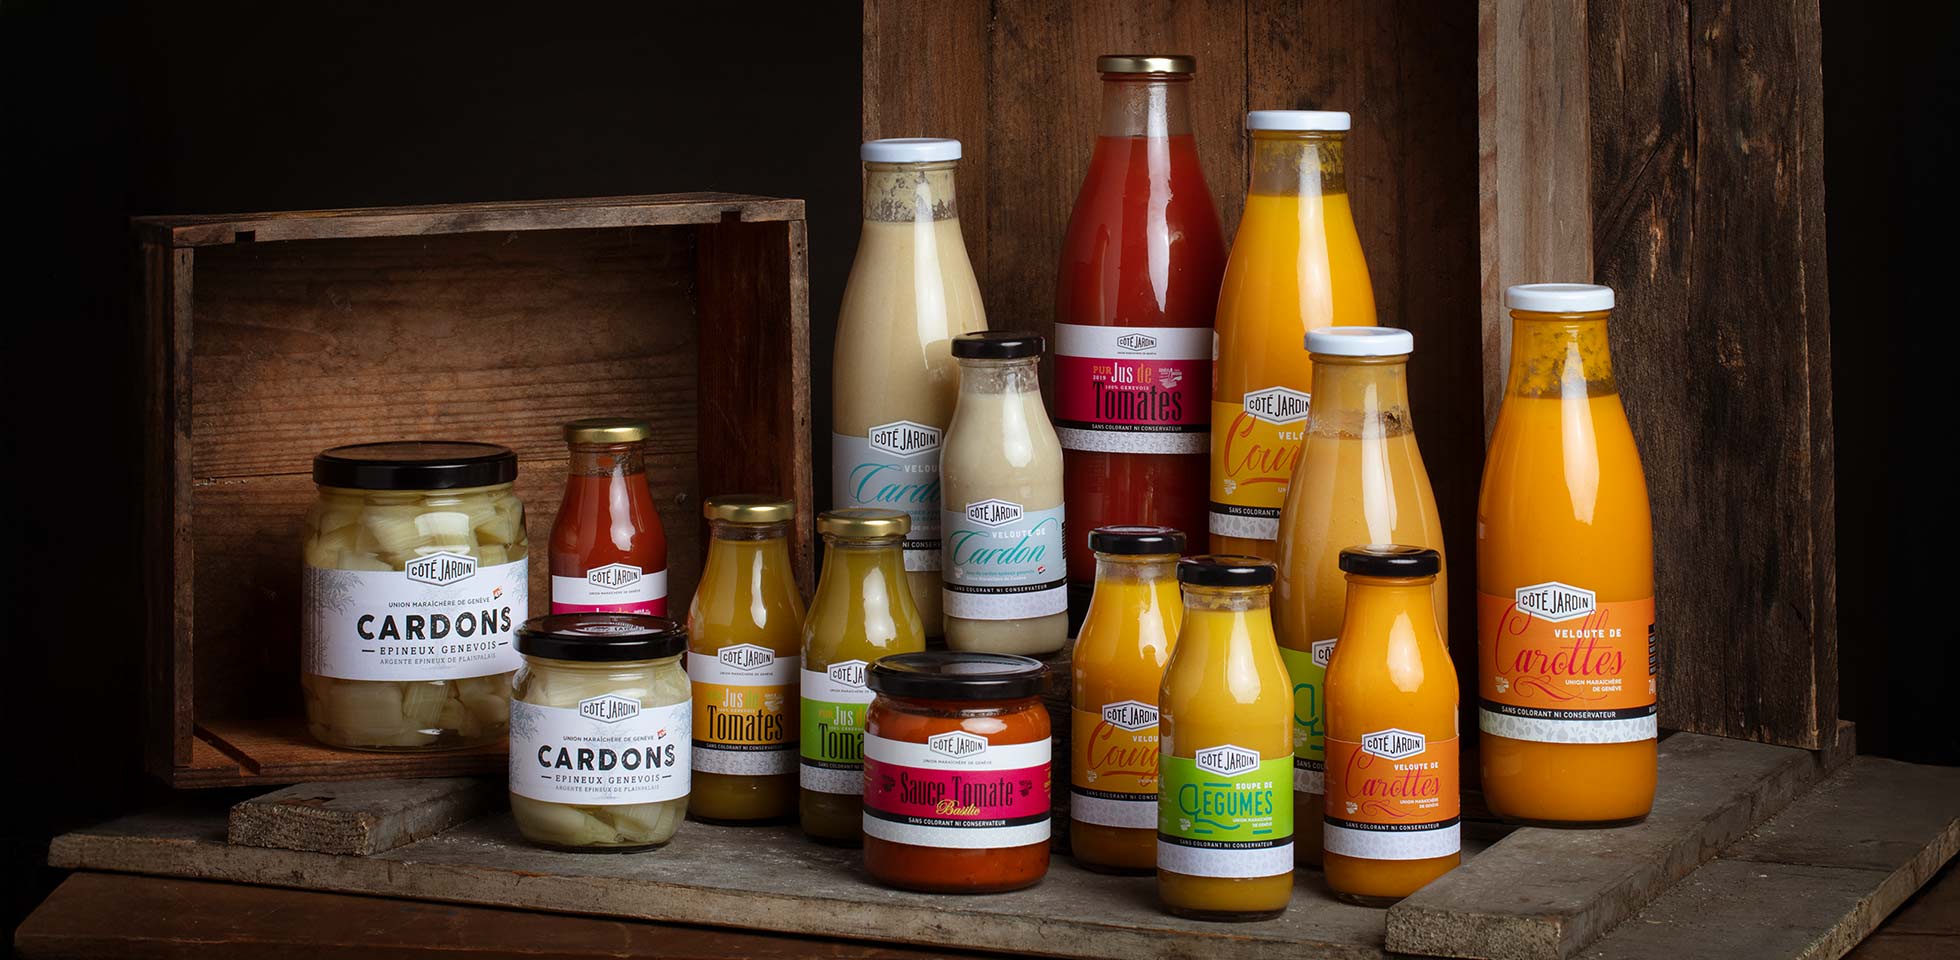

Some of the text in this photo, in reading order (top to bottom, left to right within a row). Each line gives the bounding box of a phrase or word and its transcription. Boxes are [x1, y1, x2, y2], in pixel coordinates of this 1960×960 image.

[1134, 336, 1154, 348] JARDIN
[1092, 365, 1112, 374] PUR
[1111, 362, 1132, 383] Jus
[1137, 363, 1152, 383] de
[1092, 381, 1182, 422] Tomates
[1249, 394, 1274, 414] CÔTÉ
[875, 428, 936, 451] CÔTÉ JARDIN
[970, 504, 1018, 523] CÔTÉ JARDIN
[1228, 506, 1242, 514] SANS
[1243, 508, 1275, 516] COLORANT
[948, 517, 1059, 566] Cardon
[992, 529, 1032, 539] VELOUTE
[411, 559, 472, 581] CÔTÉ JARDIN
[612, 569, 638, 586] JARDIN
[1005, 584, 1048, 593] CONSERVATEUR
[1522, 590, 1589, 614] CÔTÉ JARDIN
[357, 606, 511, 641] CARDONS
[1554, 628, 1622, 638] VELOUTE DE
[380, 640, 497, 655] EPINEUX GENEVOIS
[1495, 600, 1626, 676] Carottes
[743, 649, 771, 667] JARDIN
[723, 687, 743, 707] Jus
[584, 700, 637, 719] CÔTÉ JARDIN
[833, 705, 854, 726] Jus
[1107, 707, 1158, 725] CÔTÉ JARDIN
[1502, 706, 1516, 714] SANS
[1517, 708, 1552, 718] COLORANT
[1563, 711, 1617, 719] CONSERVATEUR
[707, 704, 783, 741] Tomates
[933, 737, 983, 755] CÔTÉ JARDIN
[1367, 735, 1420, 754] CÔTÉ JARDIN
[538, 744, 676, 771] CARDONS
[1201, 751, 1254, 771] CÔTÉ JARDIN
[1394, 761, 1439, 771] VELOUTE DE
[556, 774, 660, 784] EPINEUX GENEVOIS
[1345, 744, 1440, 799] Carottes
[900, 771, 945, 805] Sauce
[952, 775, 1014, 808] Tomate
[1235, 781, 1272, 790] SOUPE DE
[923, 818, 954, 826] COLORANT
[963, 819, 1006, 827] CONSERVATEUR
[1360, 823, 1389, 831] COLORANT
[1399, 823, 1440, 831] CONSERVATEUR
[1192, 840, 1222, 848] COLORANT
